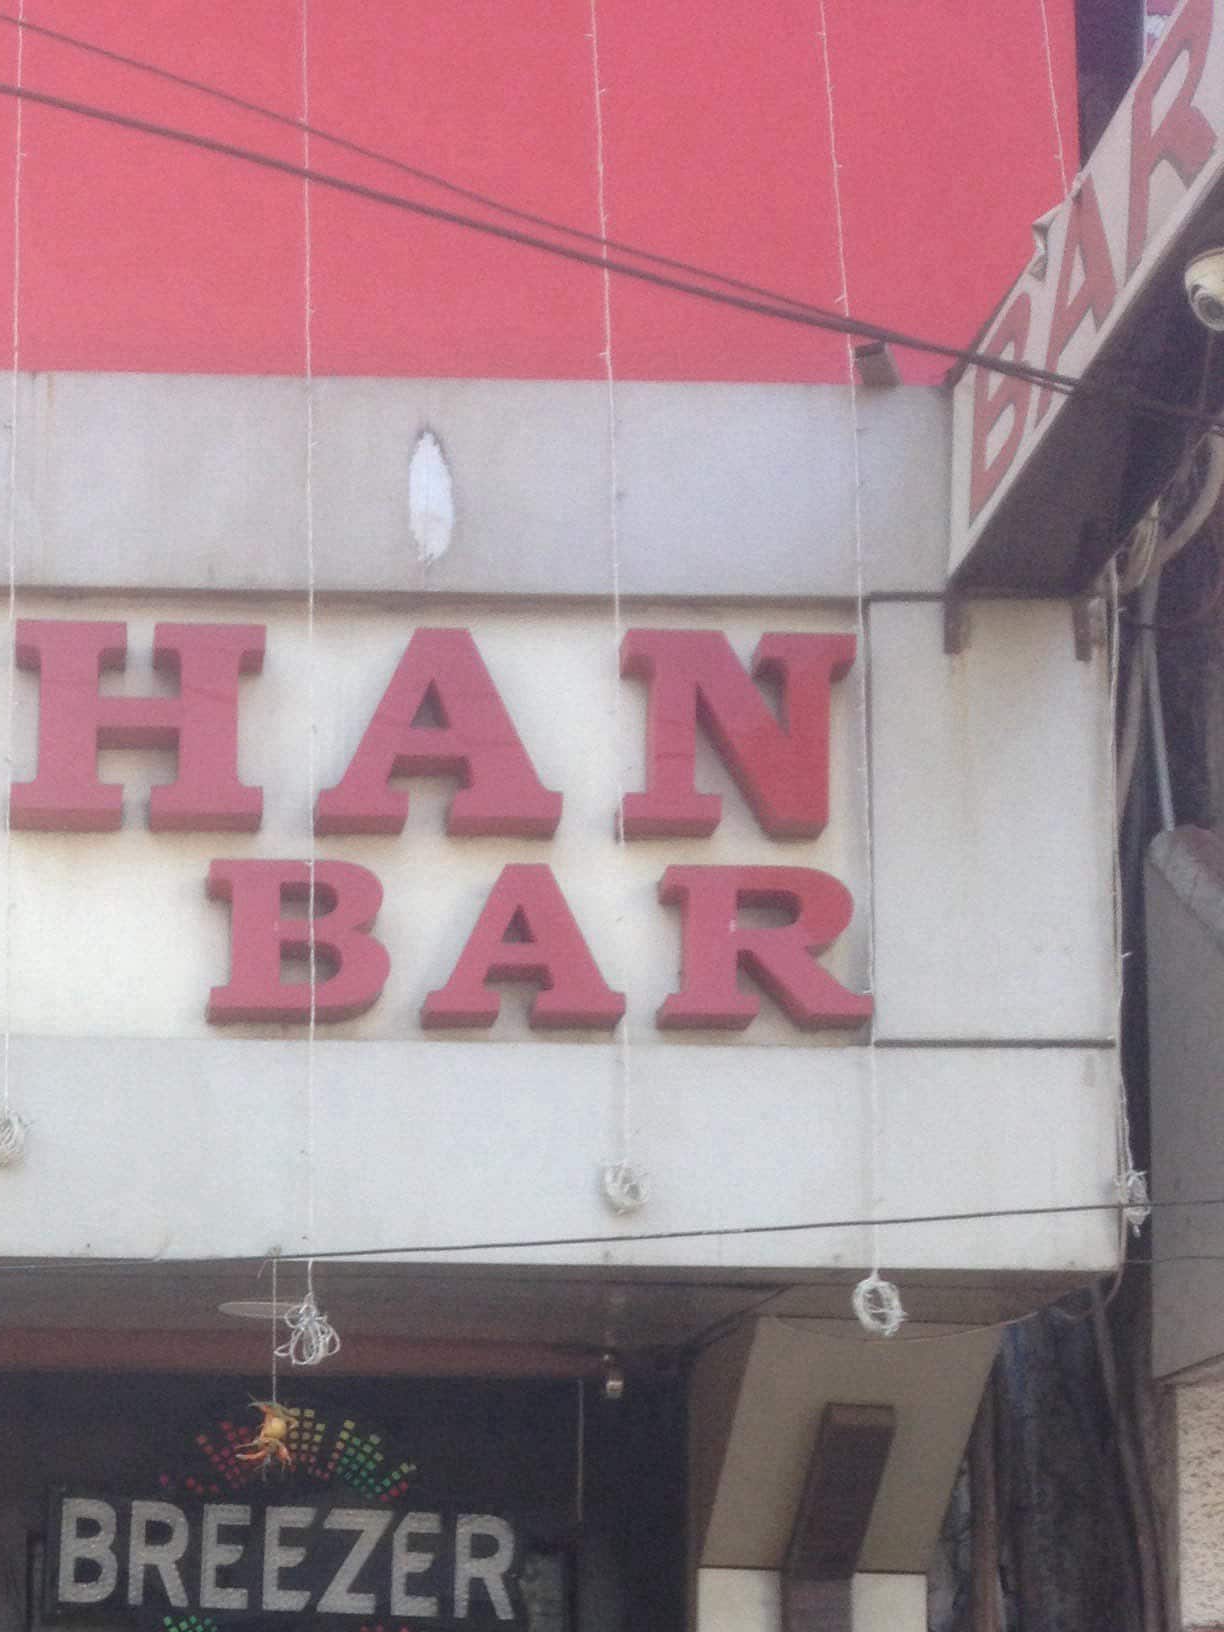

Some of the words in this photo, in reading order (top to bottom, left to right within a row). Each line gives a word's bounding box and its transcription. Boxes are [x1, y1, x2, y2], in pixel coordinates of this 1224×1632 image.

[969, 0, 1218, 525] BAR
[206, 857, 875, 1033] BAR
[57, 1498, 516, 1621] BREEZER
